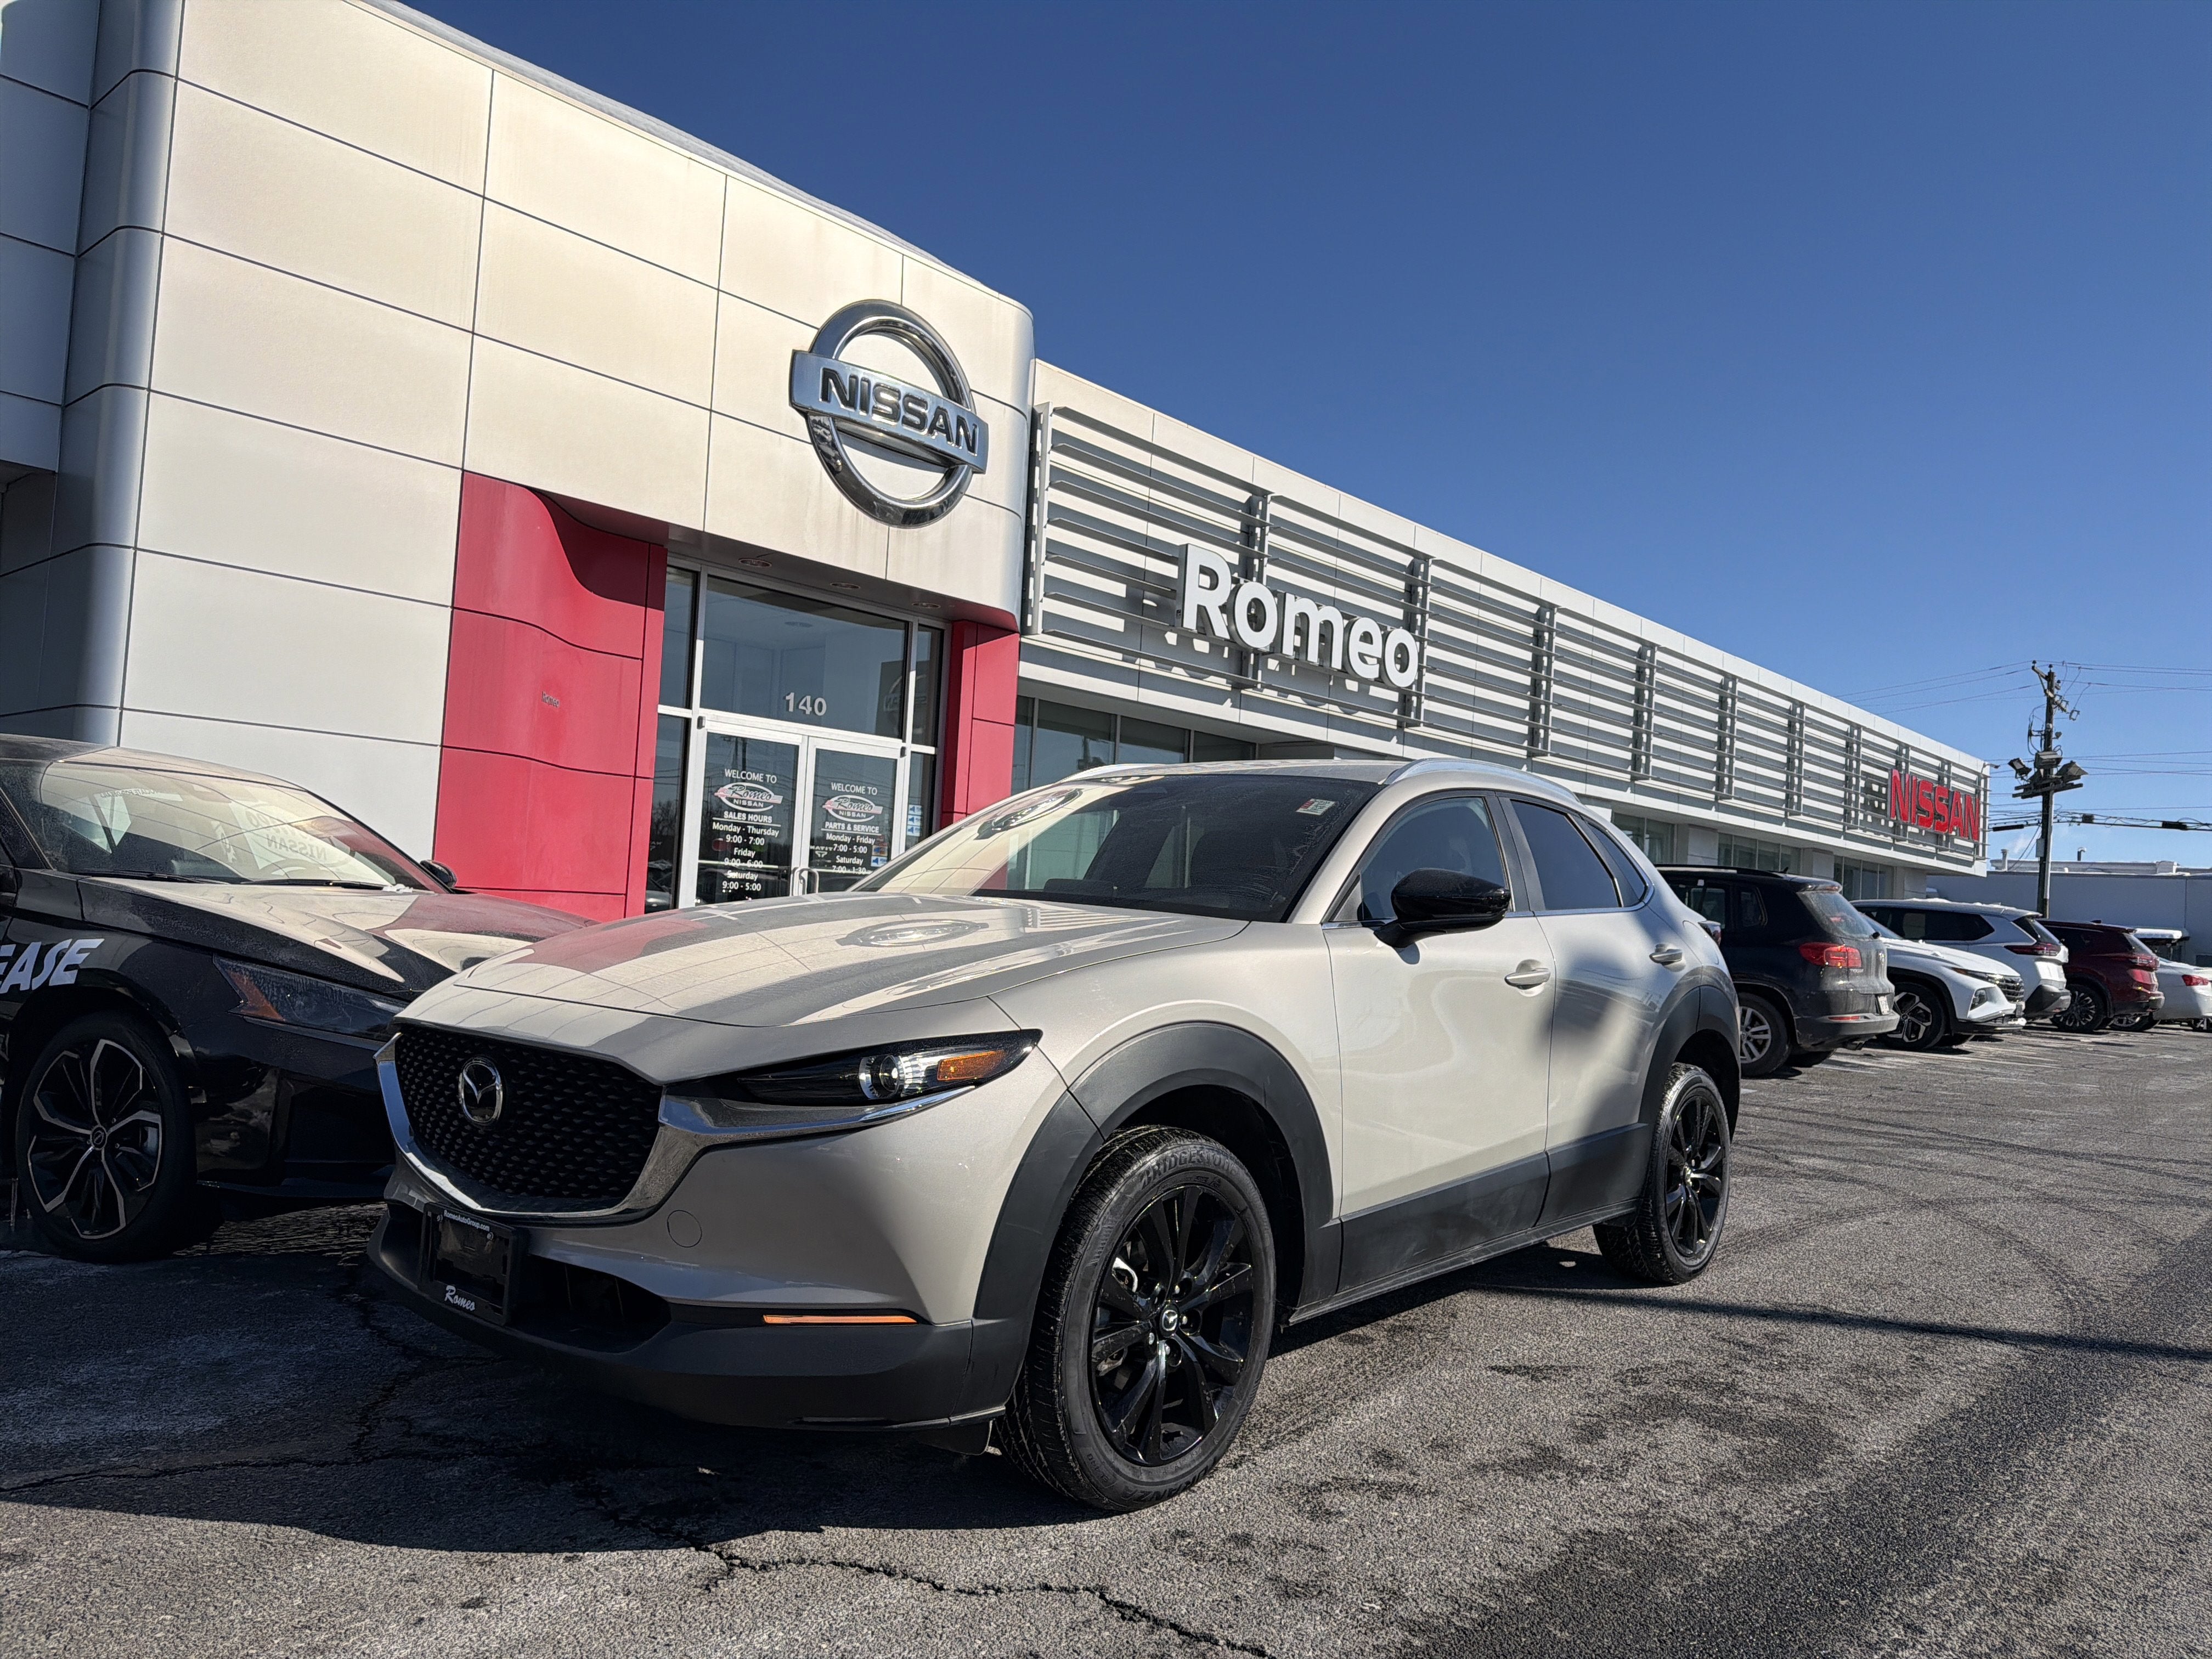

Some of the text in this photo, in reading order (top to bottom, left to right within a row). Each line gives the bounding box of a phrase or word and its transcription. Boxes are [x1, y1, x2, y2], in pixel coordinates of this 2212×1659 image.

[818, 366, 979, 457] NISSAN
[1181, 543, 1419, 687] Romeo
[785, 692, 827, 716] 140
[725, 769, 777, 783] WELCOME TO
[730, 785, 772, 800] Romeo
[831, 782, 878, 795] WELCOME TO
[733, 799, 764, 808] NISSAN
[834, 797, 873, 811] Romeo
[1890, 769, 1980, 842] NISSAN
[724, 811, 772, 823] SALES HOURS
[839, 810, 866, 818] NISSAN
[712, 822, 741, 834] Monday
[747, 825, 780, 838] Thursday
[825, 821, 845, 830] PARTS
[853, 824, 879, 833] SERVICE
[726, 834, 742, 843] 9:00
[748, 837, 765, 845] 7:00
[826, 833, 851, 843] Monday
[856, 836, 876, 845] Friday
[733, 848, 755, 858] Friday
[833, 844, 848, 852] 7:00
[853, 845, 867, 854] 5:00
[724, 857, 741, 866] 9:00
[747, 859, 763, 868] 6:00
[836, 855, 864, 866] Saturday
[727, 870, 758, 881] Saturday
[832, 865, 847, 873] 7:00
[853, 866, 866, 875] 1:30
[722, 881, 739, 890] 9:00
[745, 883, 761, 891] 5:00
[1139, 1149, 1239, 1190] BRIDGESTONE
[444, 1209, 490, 1232] RomeoAutoGroup.com
[444, 1285, 476, 1311] Romeo
